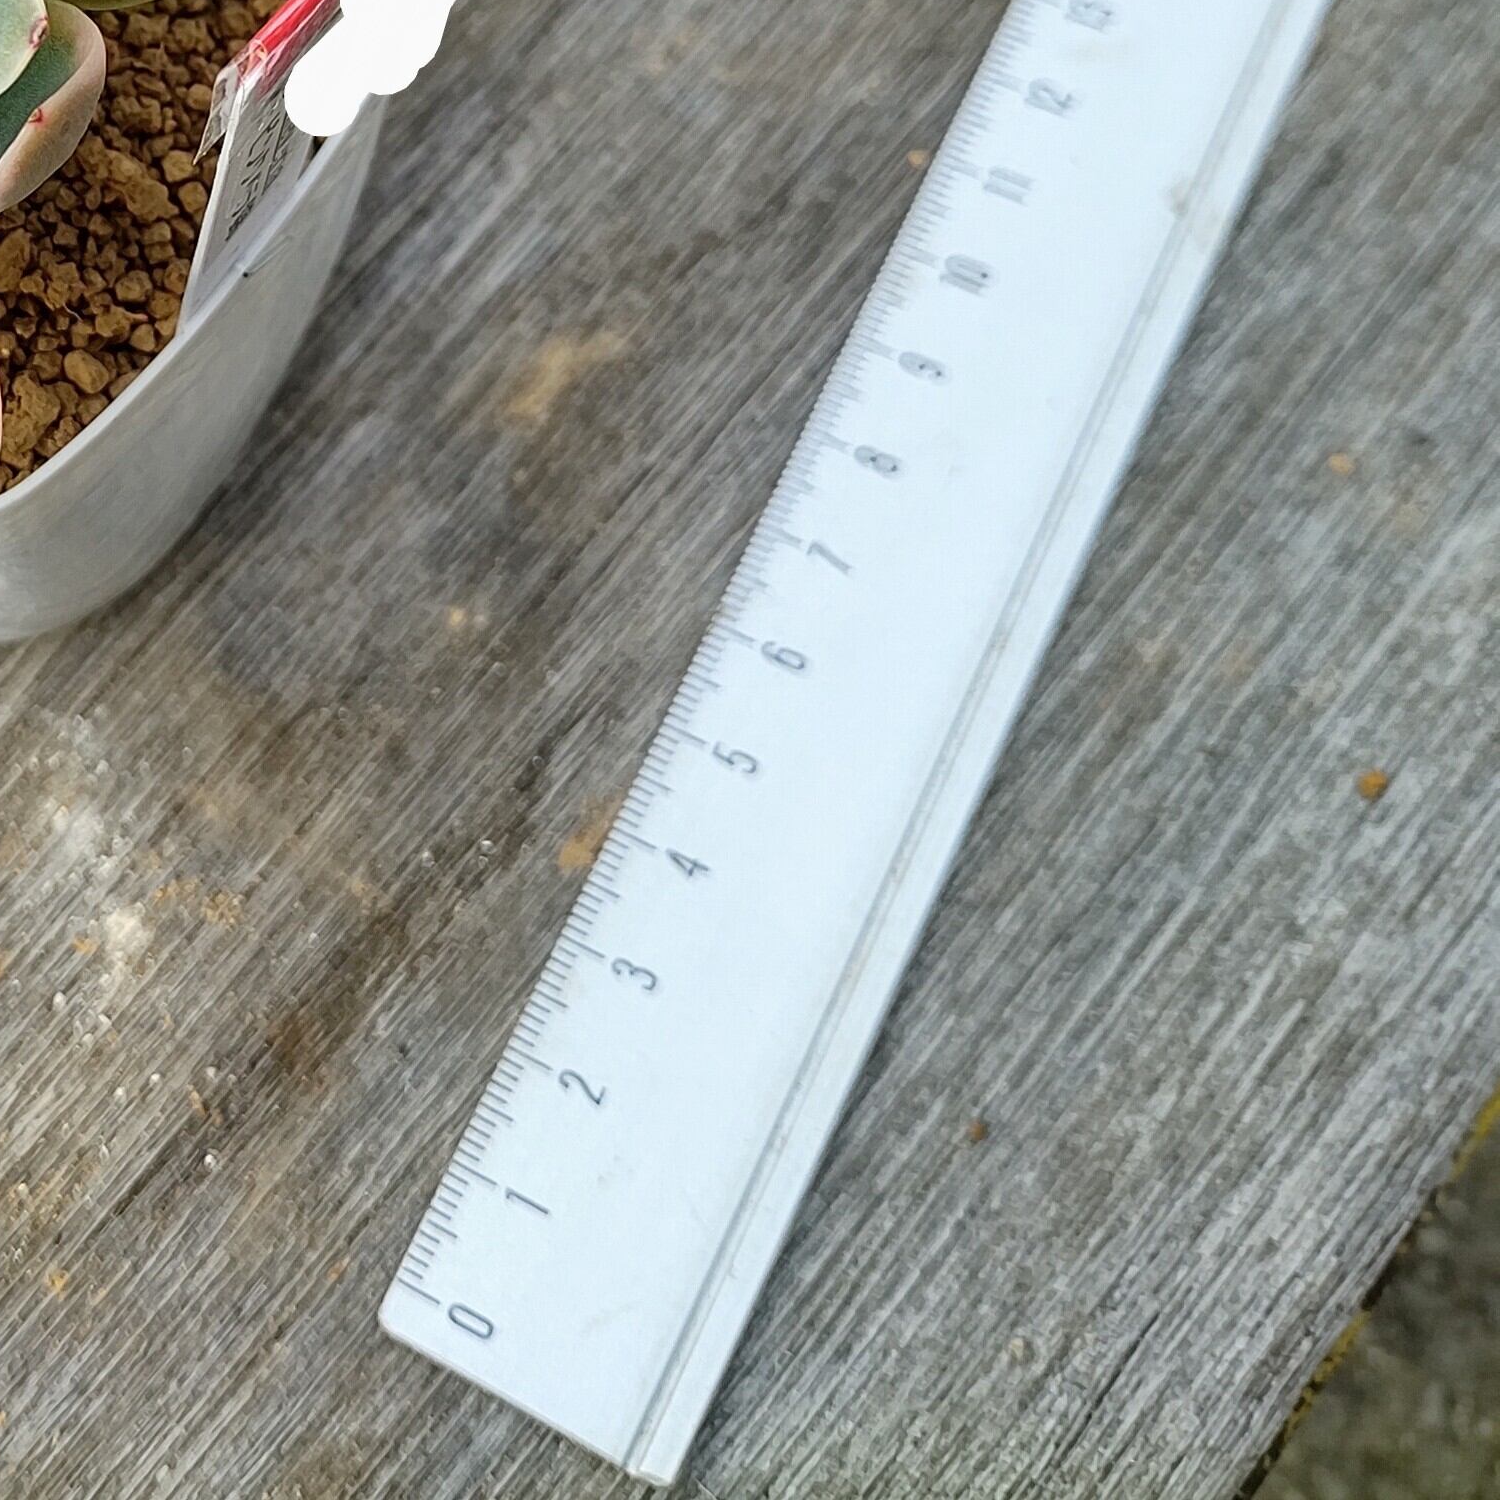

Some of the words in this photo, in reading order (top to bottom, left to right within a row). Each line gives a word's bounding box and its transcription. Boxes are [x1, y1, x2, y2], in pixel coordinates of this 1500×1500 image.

[448, 1304, 494, 1340] 0
[505, 1188, 550, 1215] 1
[558, 1069, 606, 1106] 2
[611, 958, 658, 992] 3
[666, 849, 710, 878] 4
[712, 742, 759, 774] 5
[761, 641, 808, 674] 6
[806, 540, 852, 575] 7
[853, 445, 902, 478] 8
[898, 351, 947, 381] 9
[939, 255, 993, 295] 10
[982, 166, 1036, 206] 11
[1024, 78, 1081, 118] 12
